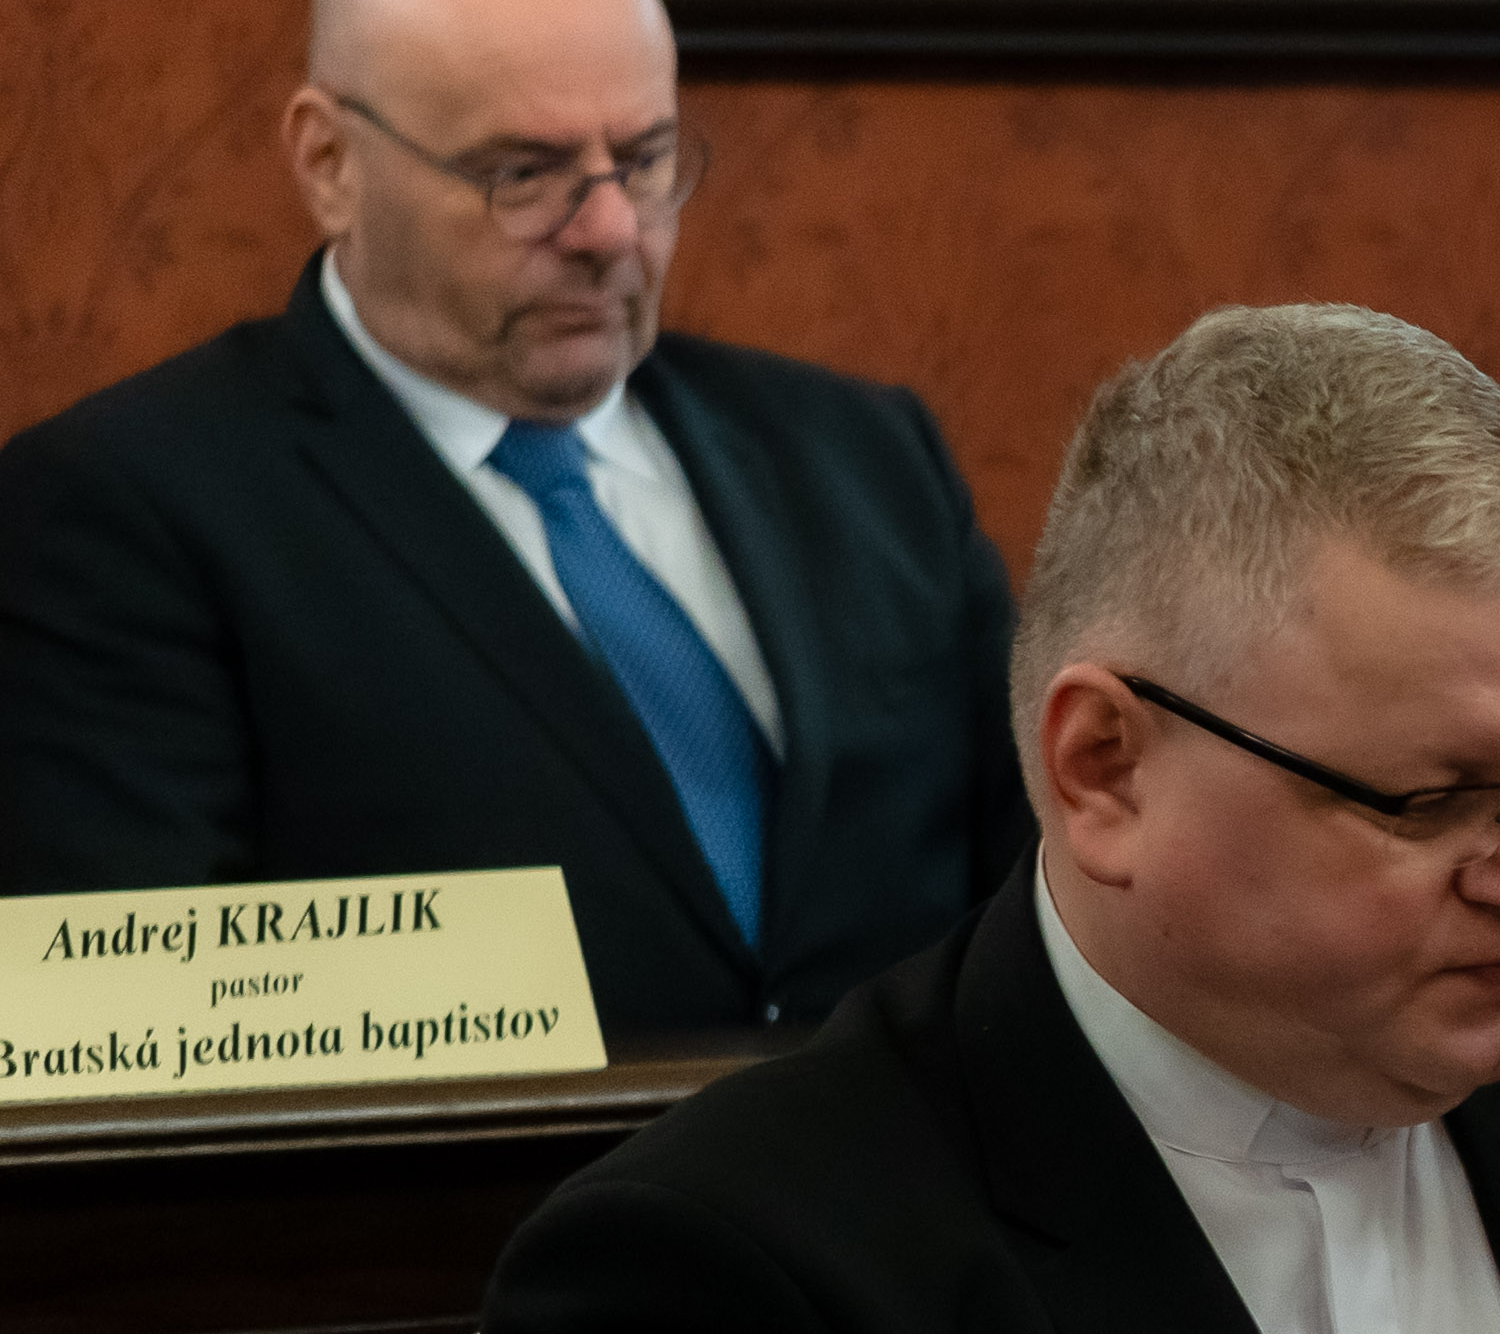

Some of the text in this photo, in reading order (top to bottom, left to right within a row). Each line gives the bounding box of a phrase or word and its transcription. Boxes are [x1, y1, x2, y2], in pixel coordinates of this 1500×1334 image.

[43, 888, 442, 963] Andrej KRAJLIK
[211, 971, 304, 1008] pastor
[174, 1021, 345, 1078] jednota
[362, 1003, 560, 1059] baptistov
